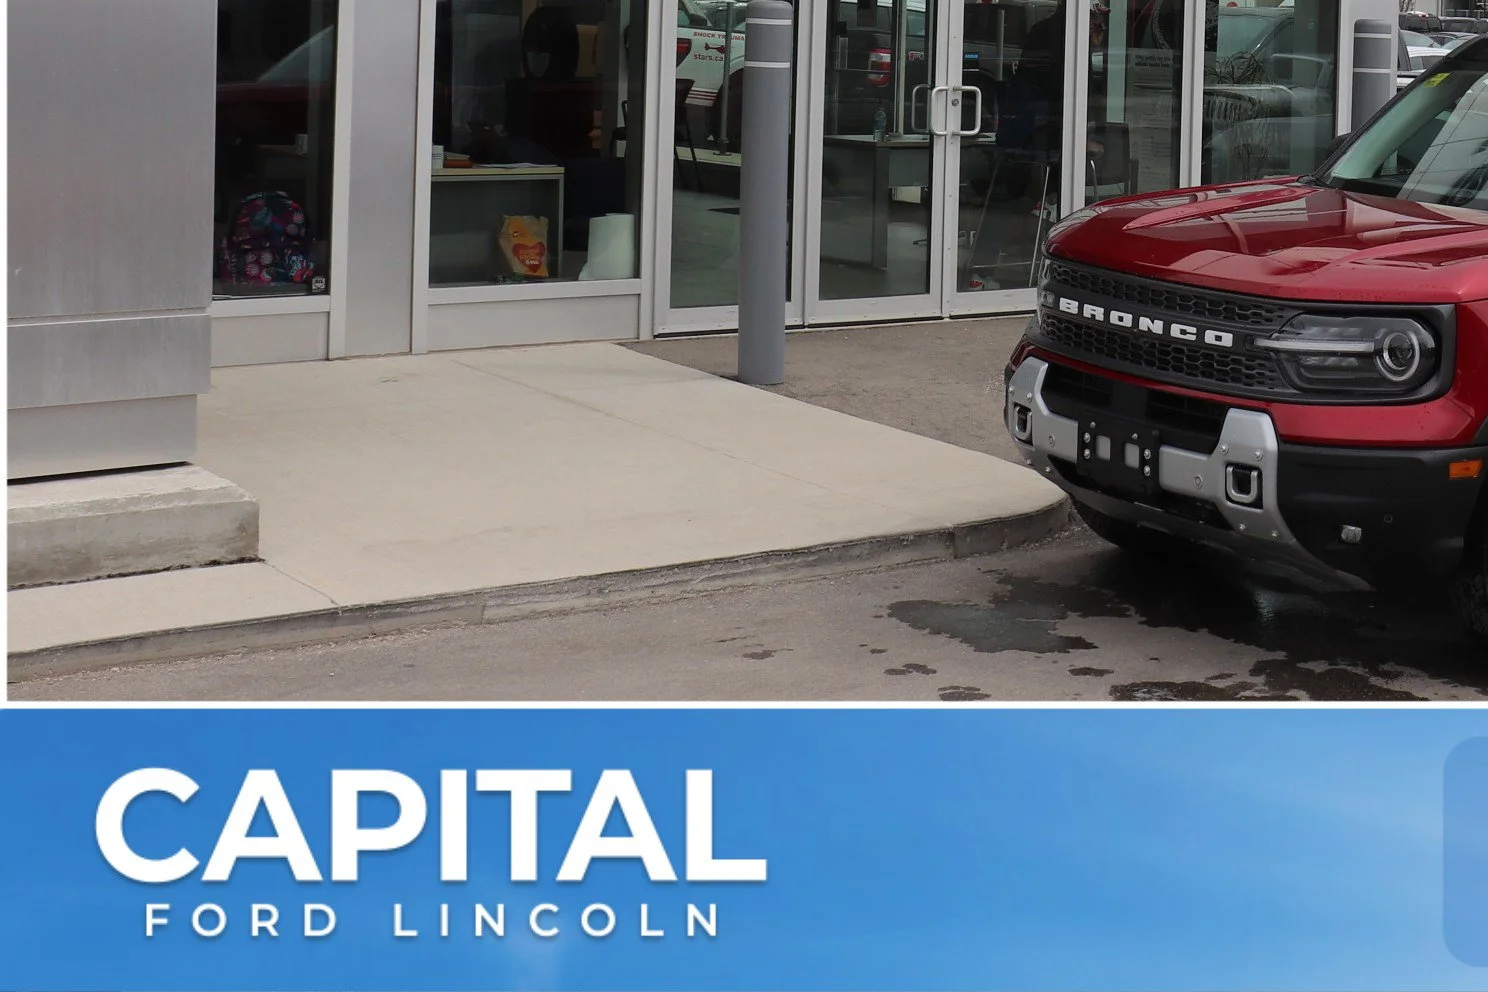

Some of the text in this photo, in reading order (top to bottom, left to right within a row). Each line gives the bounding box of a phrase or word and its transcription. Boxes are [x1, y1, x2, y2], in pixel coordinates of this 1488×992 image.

[693, 31, 716, 39] SHOCK
[693, 53, 724, 62] stars.ca
[1059, 297, 1234, 348] BRONCO
